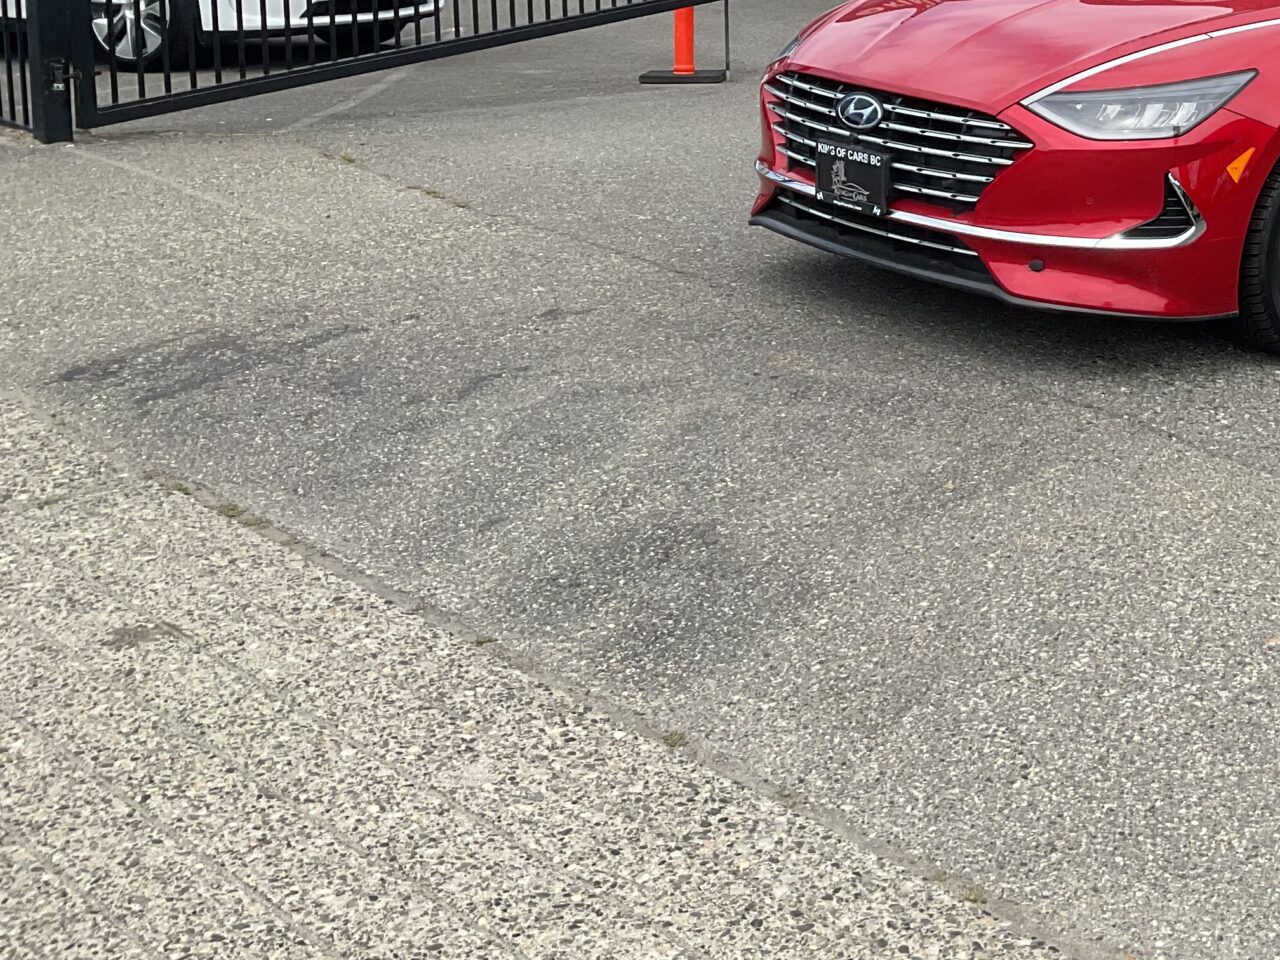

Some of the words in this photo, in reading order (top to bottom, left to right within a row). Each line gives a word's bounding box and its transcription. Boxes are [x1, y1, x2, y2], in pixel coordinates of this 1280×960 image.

[818, 143, 835, 156] KING
[836, 147, 847, 158] OF
[847, 150, 868, 163] CARS
[870, 155, 881, 166] BC
